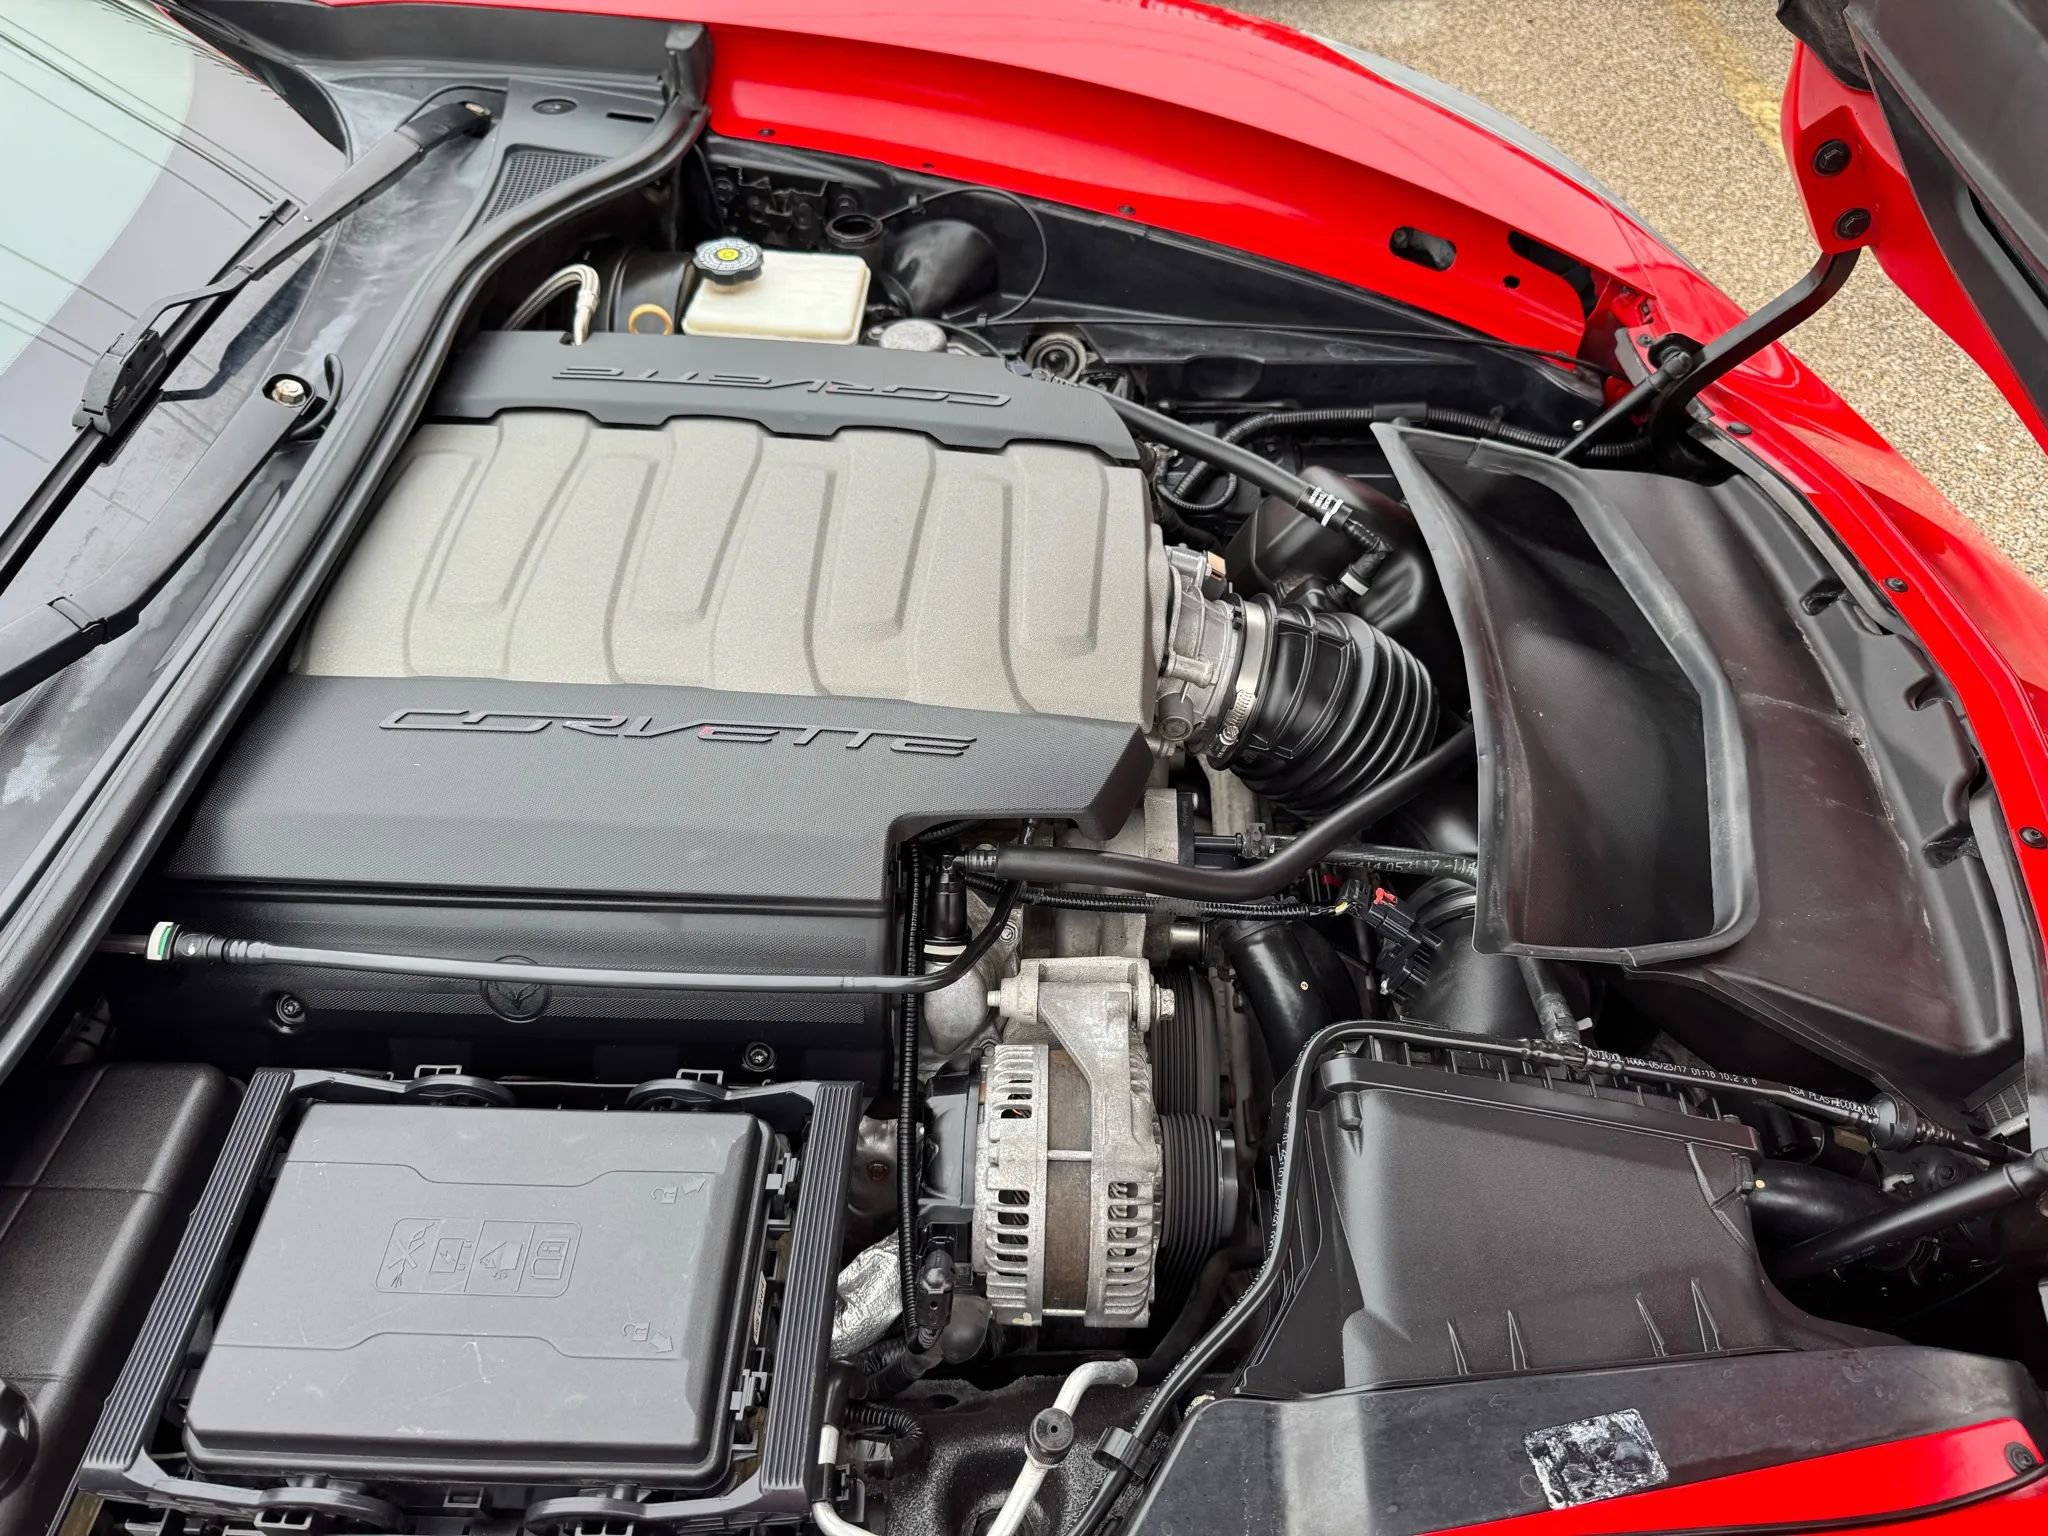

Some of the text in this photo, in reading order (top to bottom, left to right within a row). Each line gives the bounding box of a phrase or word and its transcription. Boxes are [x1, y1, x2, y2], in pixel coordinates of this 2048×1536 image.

[552, 366, 1011, 407] CORVETTE
[378, 708, 977, 756] CORVETTE
[1719, 1072, 1740, 1083] 10.2
[1788, 1085, 1805, 1097] CSA
